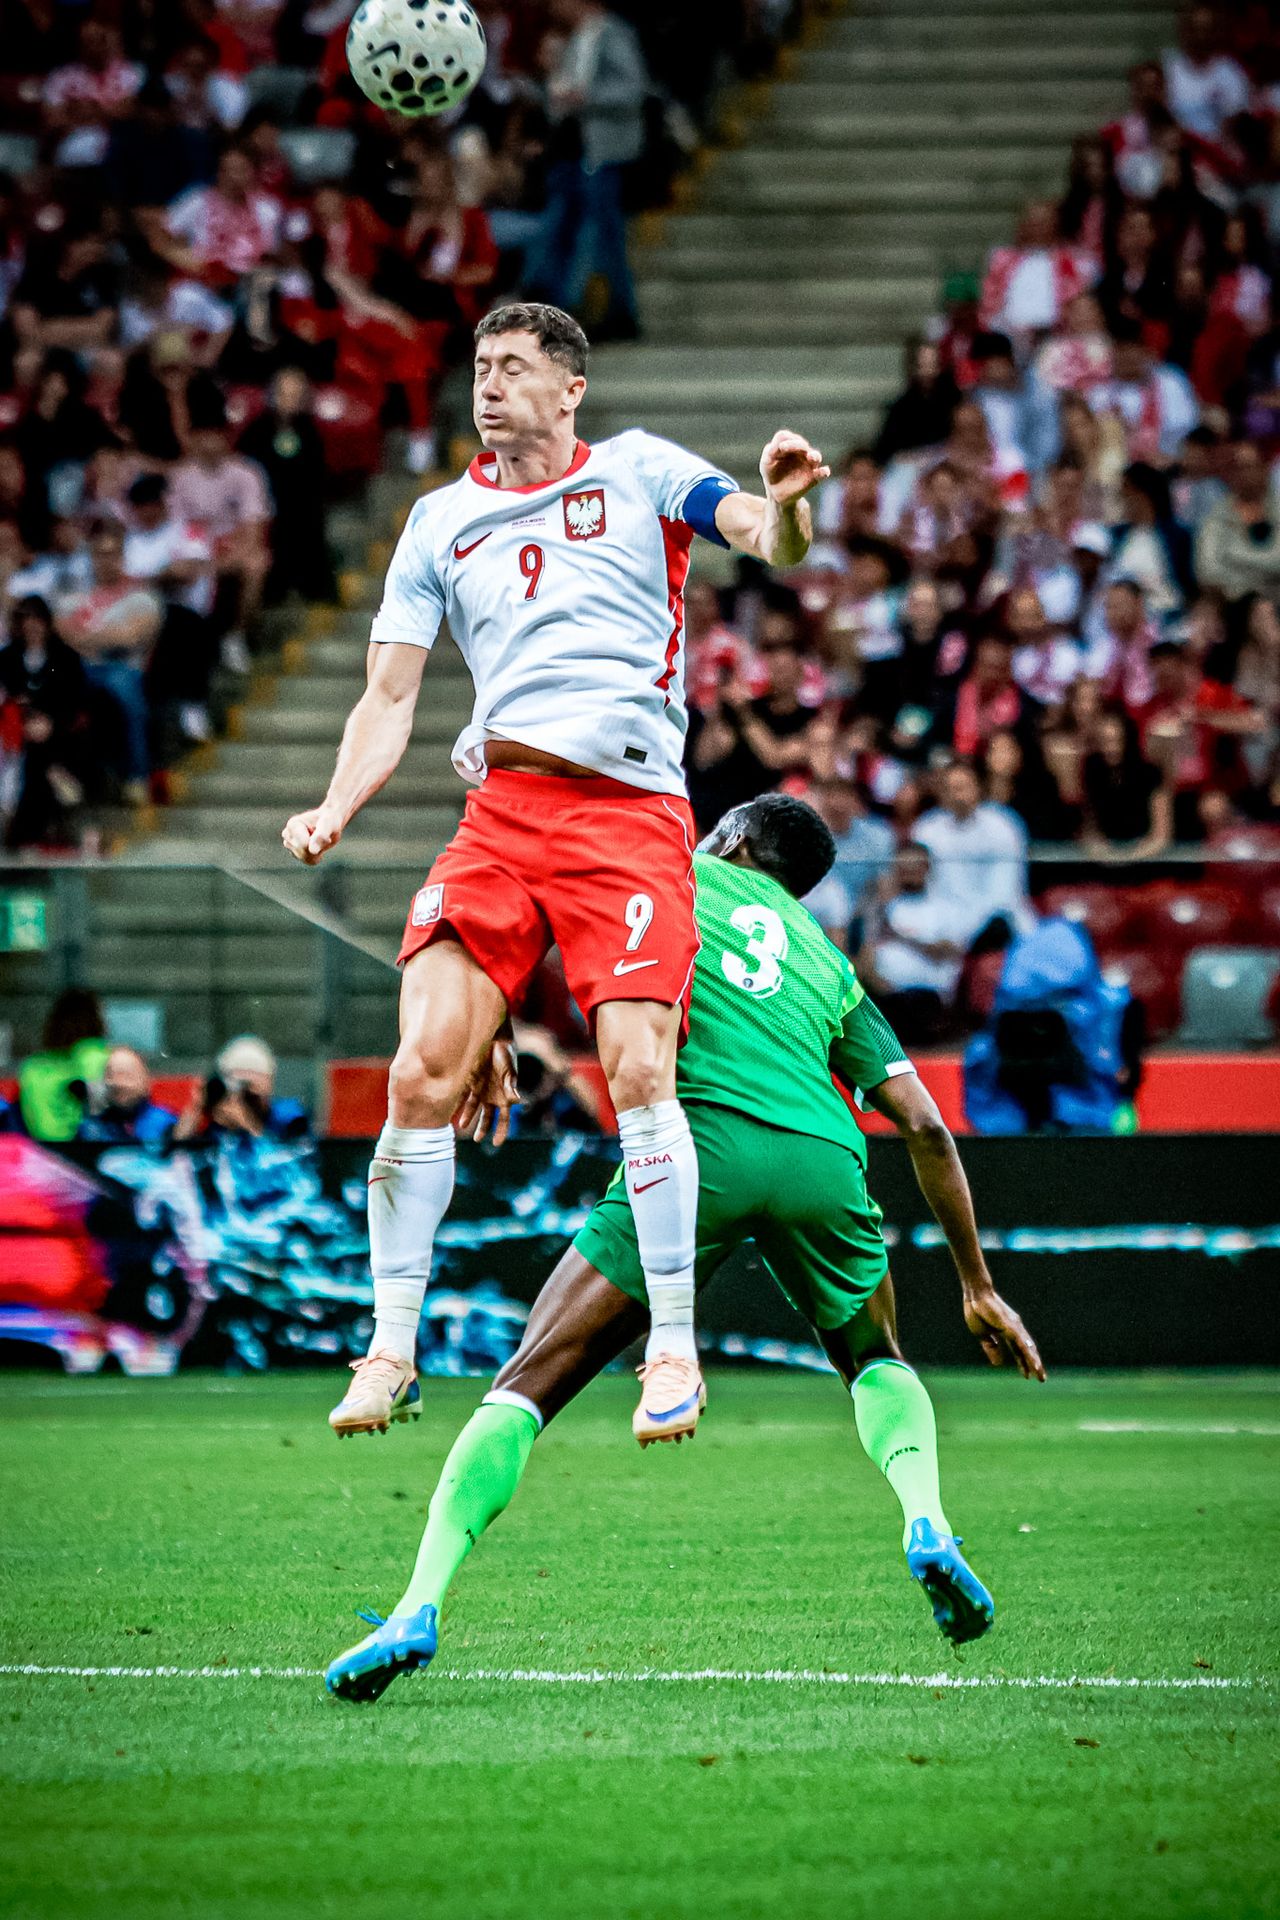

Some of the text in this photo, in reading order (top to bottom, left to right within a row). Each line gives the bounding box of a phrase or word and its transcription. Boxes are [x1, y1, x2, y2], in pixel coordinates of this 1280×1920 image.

[518, 543, 546, 601] 9
[624, 892, 655, 952] 9
[720, 904, 790, 1000] 3
